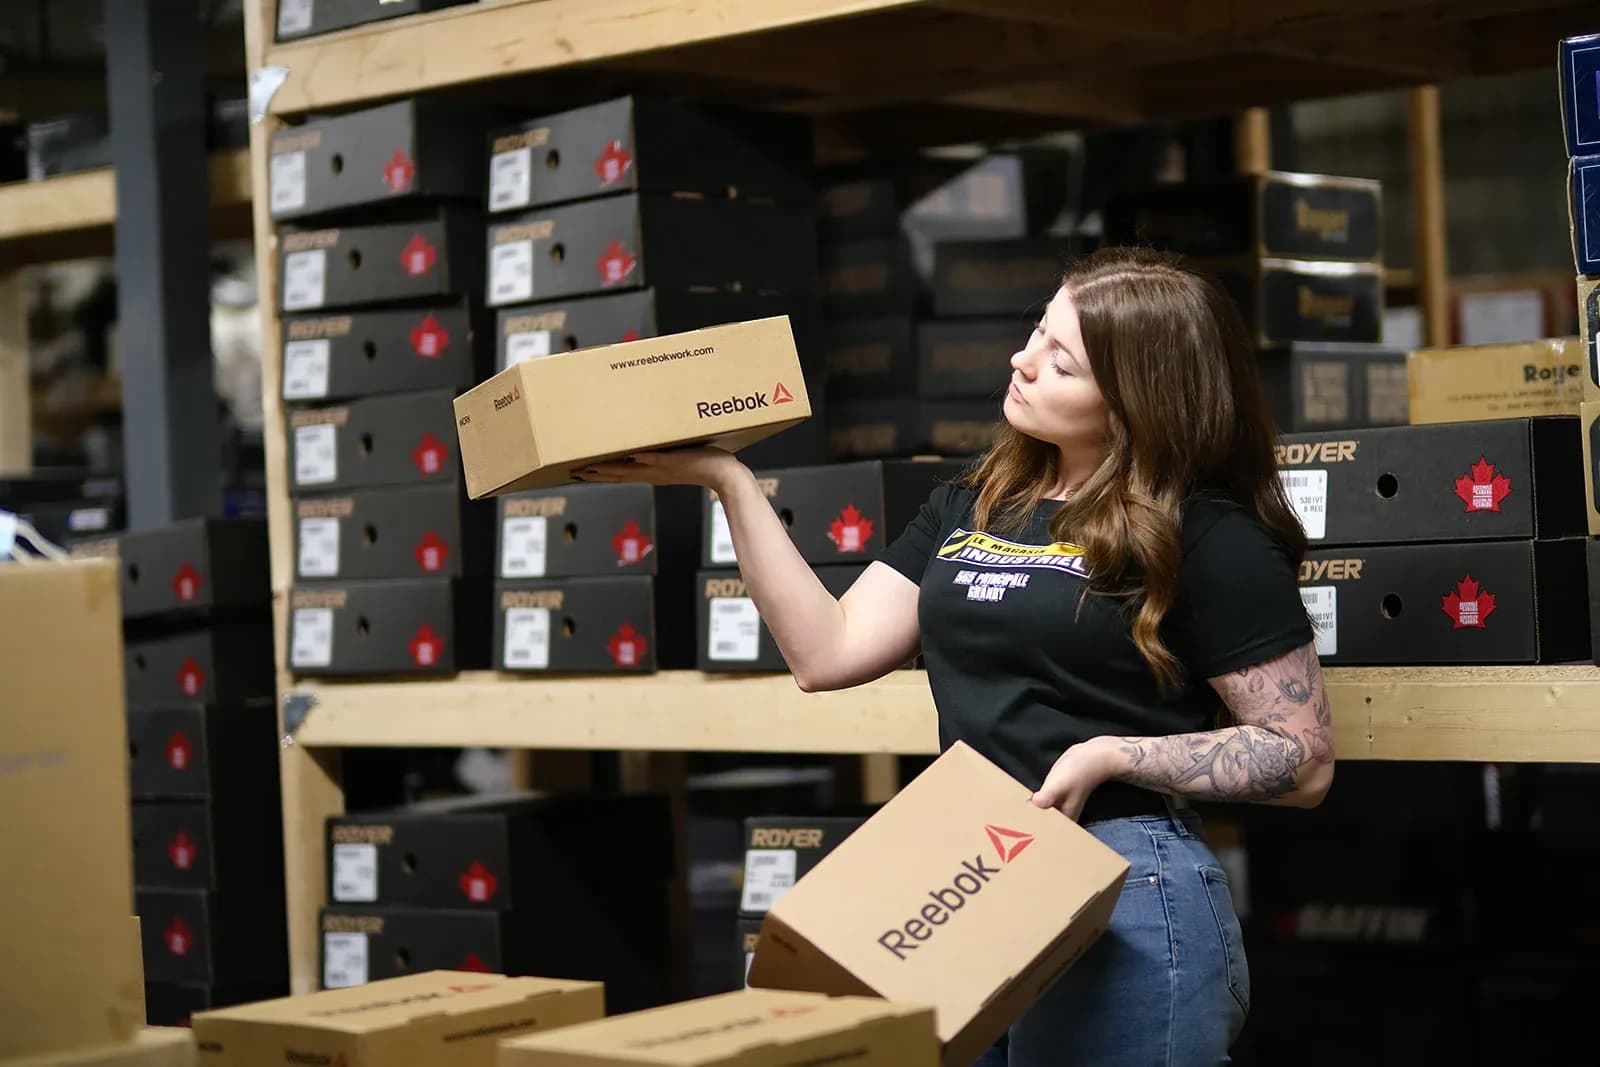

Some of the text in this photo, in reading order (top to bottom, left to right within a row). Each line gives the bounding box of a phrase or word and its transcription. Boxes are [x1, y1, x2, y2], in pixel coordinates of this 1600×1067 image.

[610, 345, 714, 370] www.reebokwork.com
[1523, 364, 1580, 384] Roye
[494, 391, 513, 411] Reebok
[697, 392, 768, 418] Reebok
[1274, 440, 1357, 465] ROYER
[972, 536, 987, 545] LE
[960, 546, 1086, 572] INDUSTRIEL
[1298, 558, 1363, 581] OYER
[706, 579, 747, 598] ROY
[752, 828, 824, 848] ROYER
[878, 854, 1000, 960] Reebok
